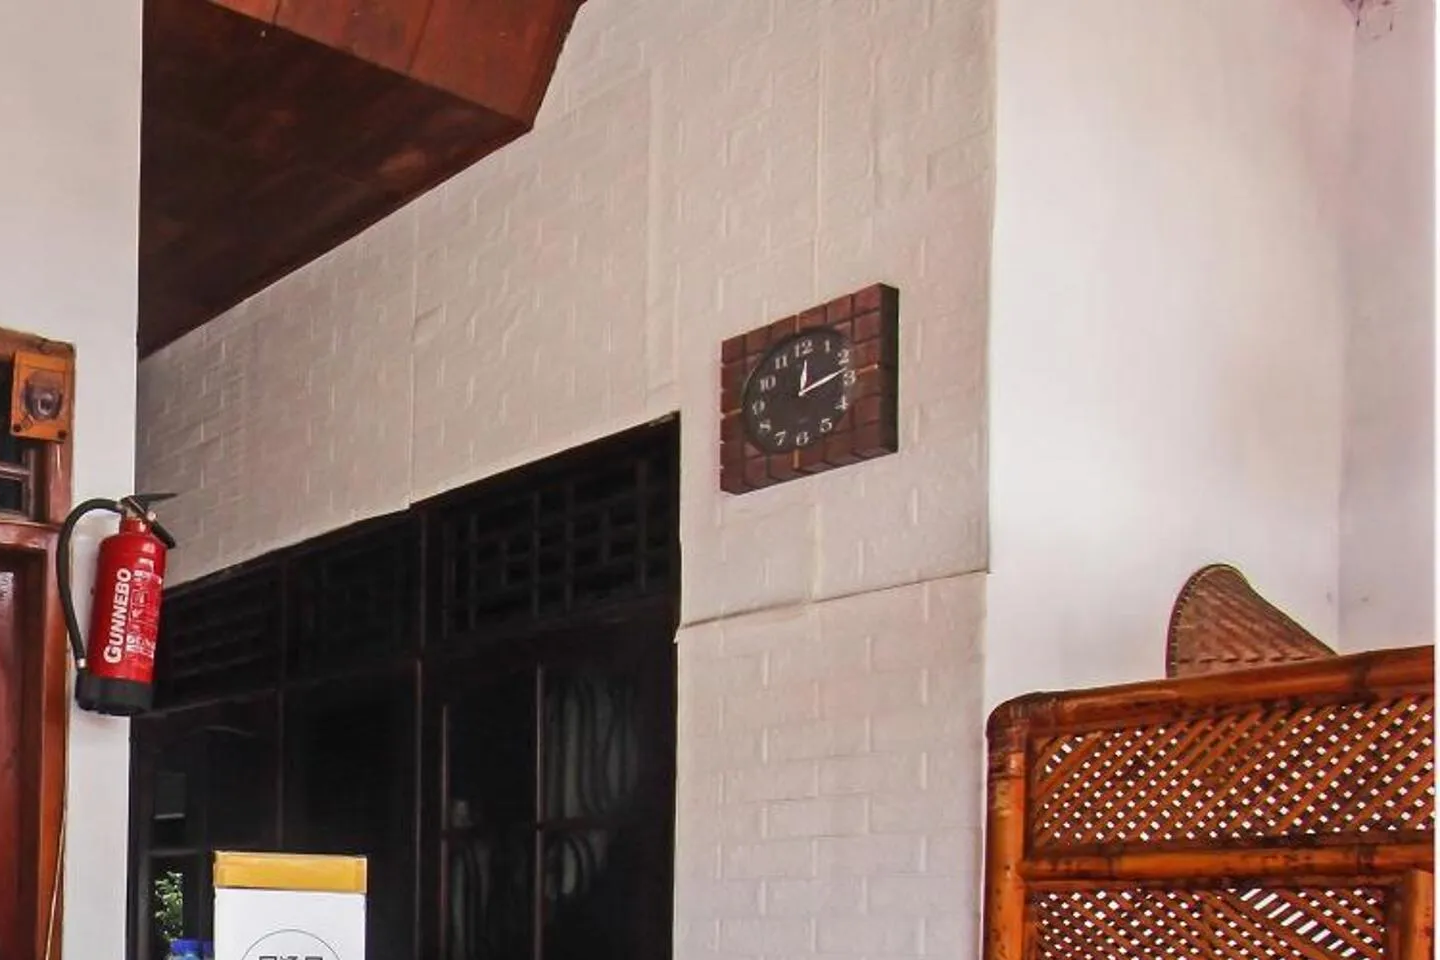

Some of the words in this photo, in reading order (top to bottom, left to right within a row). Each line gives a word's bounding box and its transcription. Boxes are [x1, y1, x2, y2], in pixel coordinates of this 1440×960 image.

[793, 339, 814, 358] 12
[824, 339, 831, 353] 1
[774, 354, 790, 370] 11
[837, 349, 850, 365] 2
[759, 374, 777, 391] 10
[843, 370, 857, 386] 3
[752, 400, 766, 415] 9
[834, 395, 849, 411] 4
[759, 419, 772, 436] 8
[819, 418, 833, 433] 5
[774, 431, 787, 446] 7
[795, 431, 810, 447] 6
[103, 567, 132, 664] GUNNEBO
